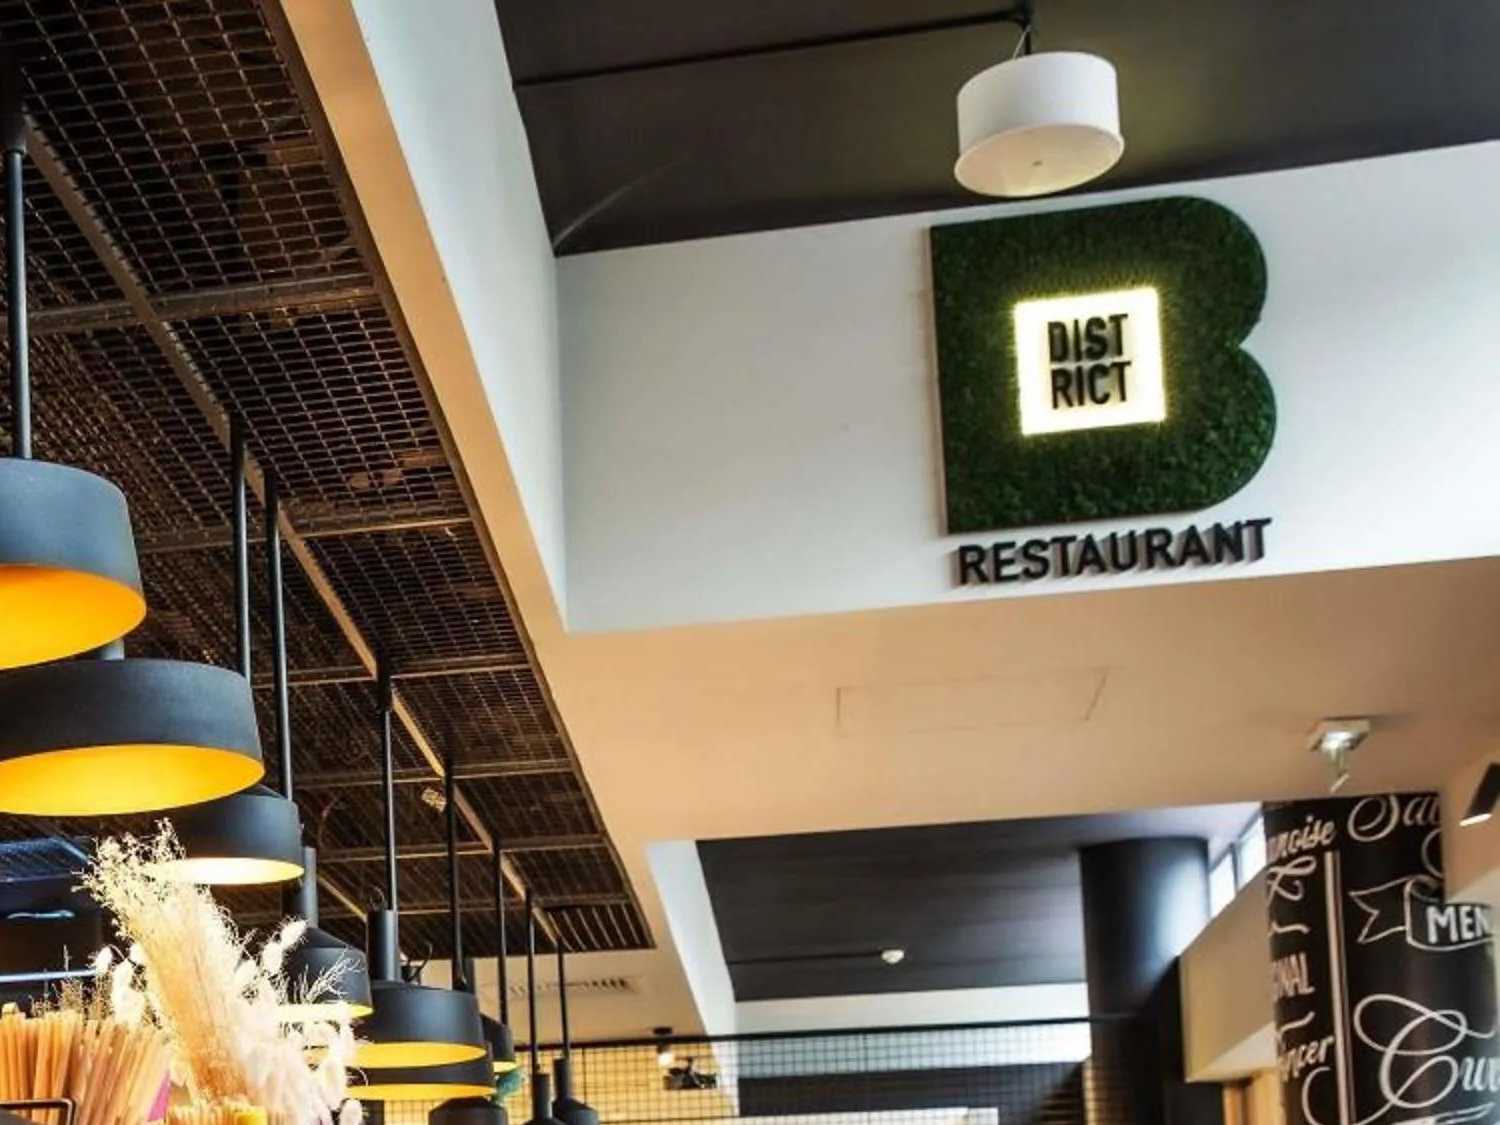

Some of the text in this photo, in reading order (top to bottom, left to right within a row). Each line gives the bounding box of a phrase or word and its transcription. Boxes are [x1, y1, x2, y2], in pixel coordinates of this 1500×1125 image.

[1047, 313, 1129, 364] DIST
[1050, 361, 1132, 410] RICT
[955, 517, 1273, 588] RESTAURANT
